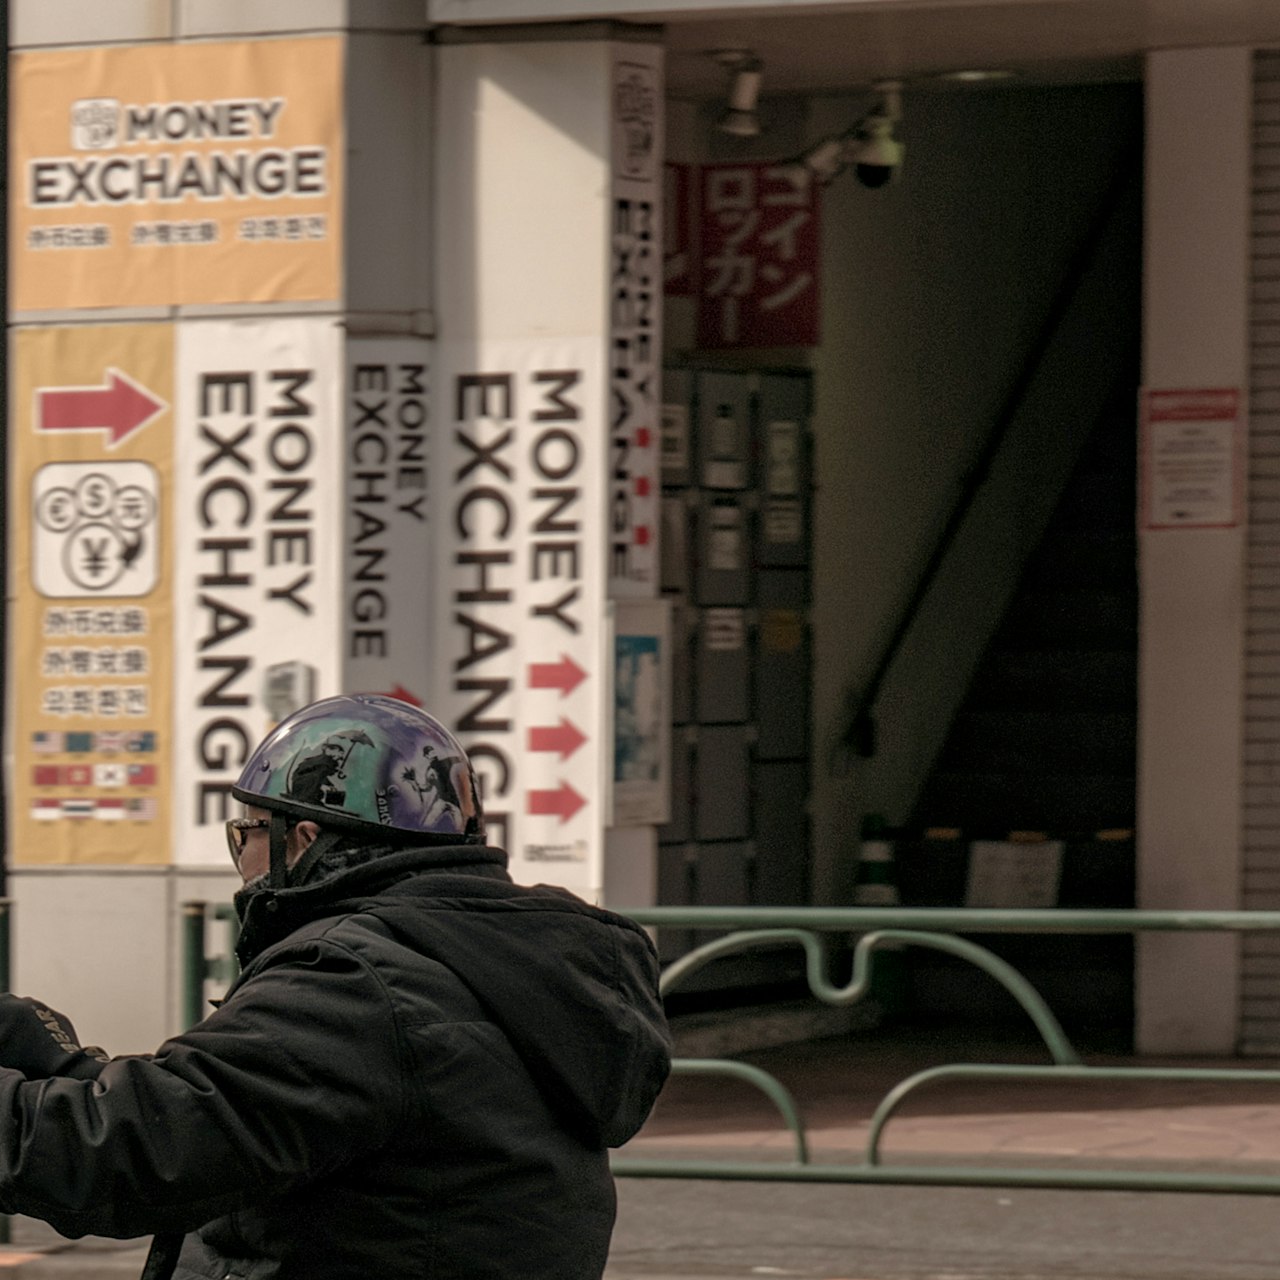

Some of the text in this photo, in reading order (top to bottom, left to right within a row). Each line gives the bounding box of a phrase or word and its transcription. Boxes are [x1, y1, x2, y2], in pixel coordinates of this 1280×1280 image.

[32, 151, 324, 204] EXCHANGE
[127, 100, 283, 142] MONEY
[265, 369, 314, 618] MONEY
[351, 363, 389, 658] EXCHANGE
[397, 363, 427, 523] MONEY
[530, 369, 582, 635] MONEY
[197, 371, 254, 826] EXCHANGE
